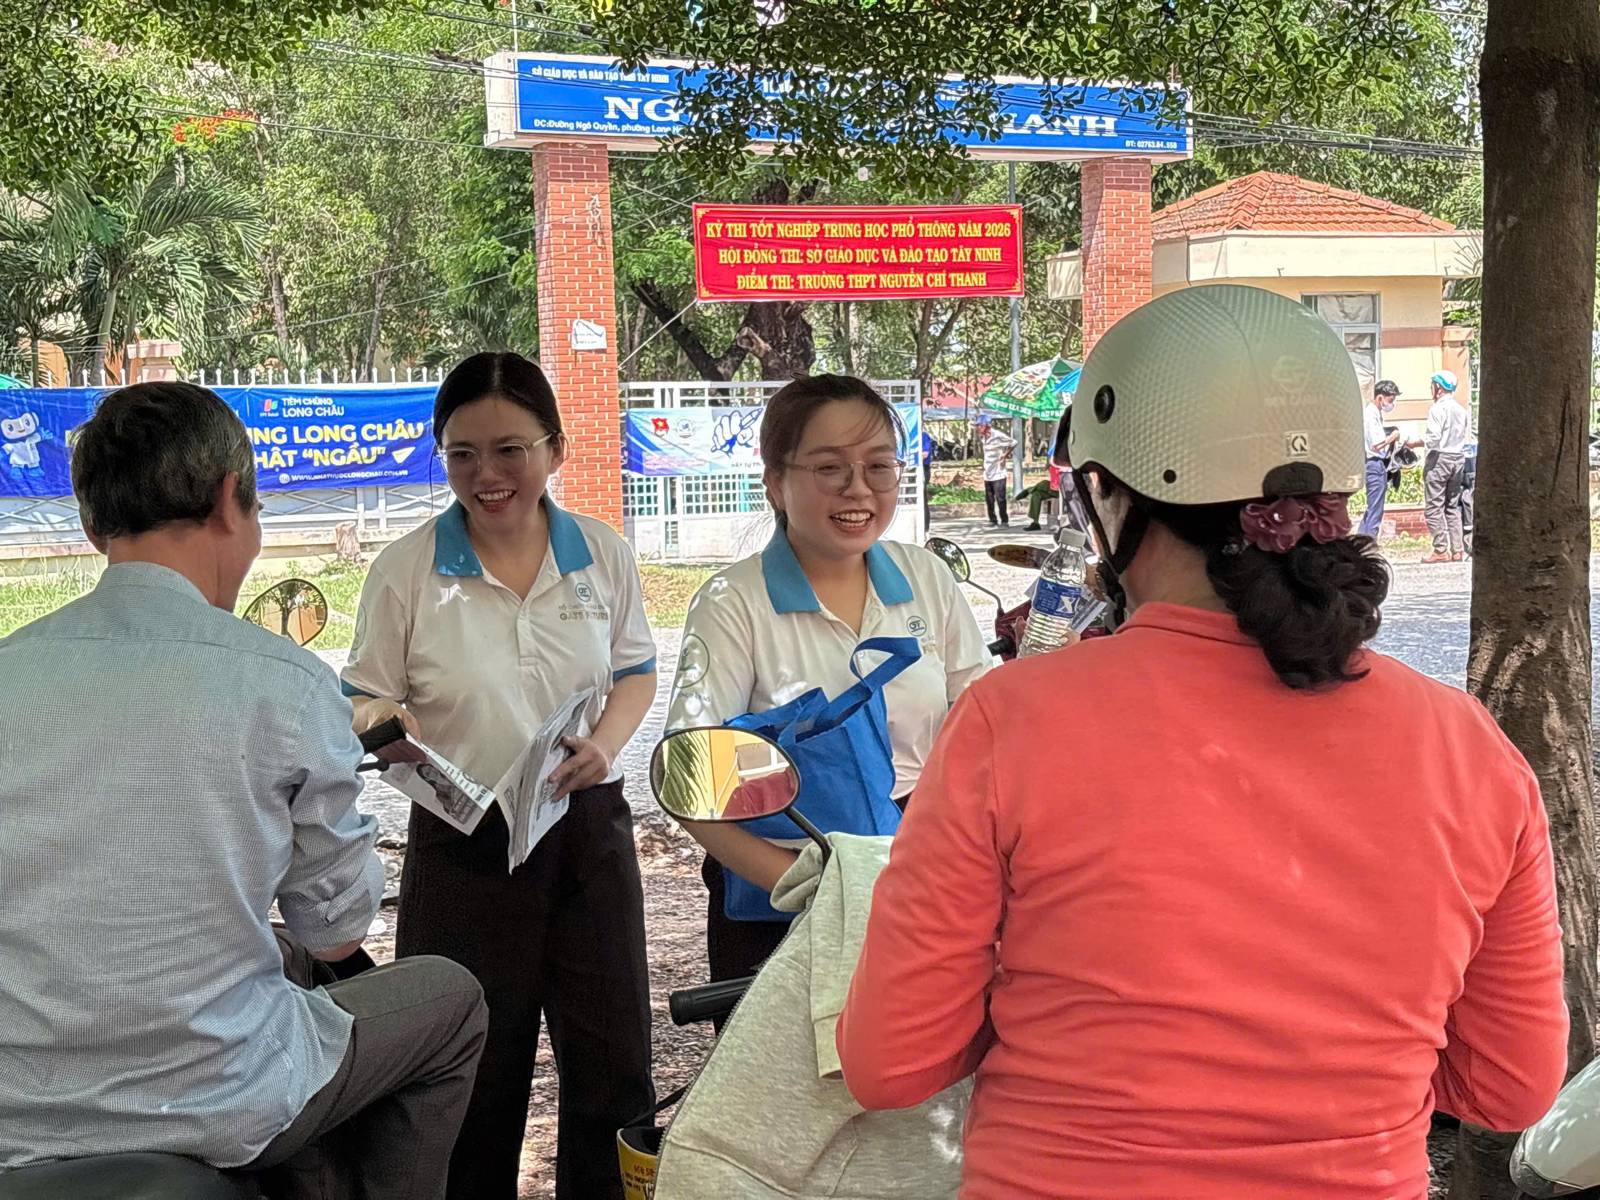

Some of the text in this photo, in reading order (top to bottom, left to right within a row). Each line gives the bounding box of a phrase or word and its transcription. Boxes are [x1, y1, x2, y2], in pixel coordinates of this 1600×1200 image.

[706, 215, 1011, 241] KỲ THI TỐT NGHIỆP TRUNG HỌC PHỔ THÔNG NĂM 2026
[719, 242, 1001, 268] HỘI ĐỒNG THI: SỞ GIÁO DỤC VÀ ĐÀO TẠO TÂY NINH
[737, 266, 987, 290] ĐIỂM THI: TRƯỜNG THPT NGUYỄN CHÍ THANH
[282, 407, 313, 418] LONG
[315, 404, 345, 417] CHÂU
[247, 419, 425, 446] NG LONG CHÂU
[254, 447, 298, 472] HẬT
